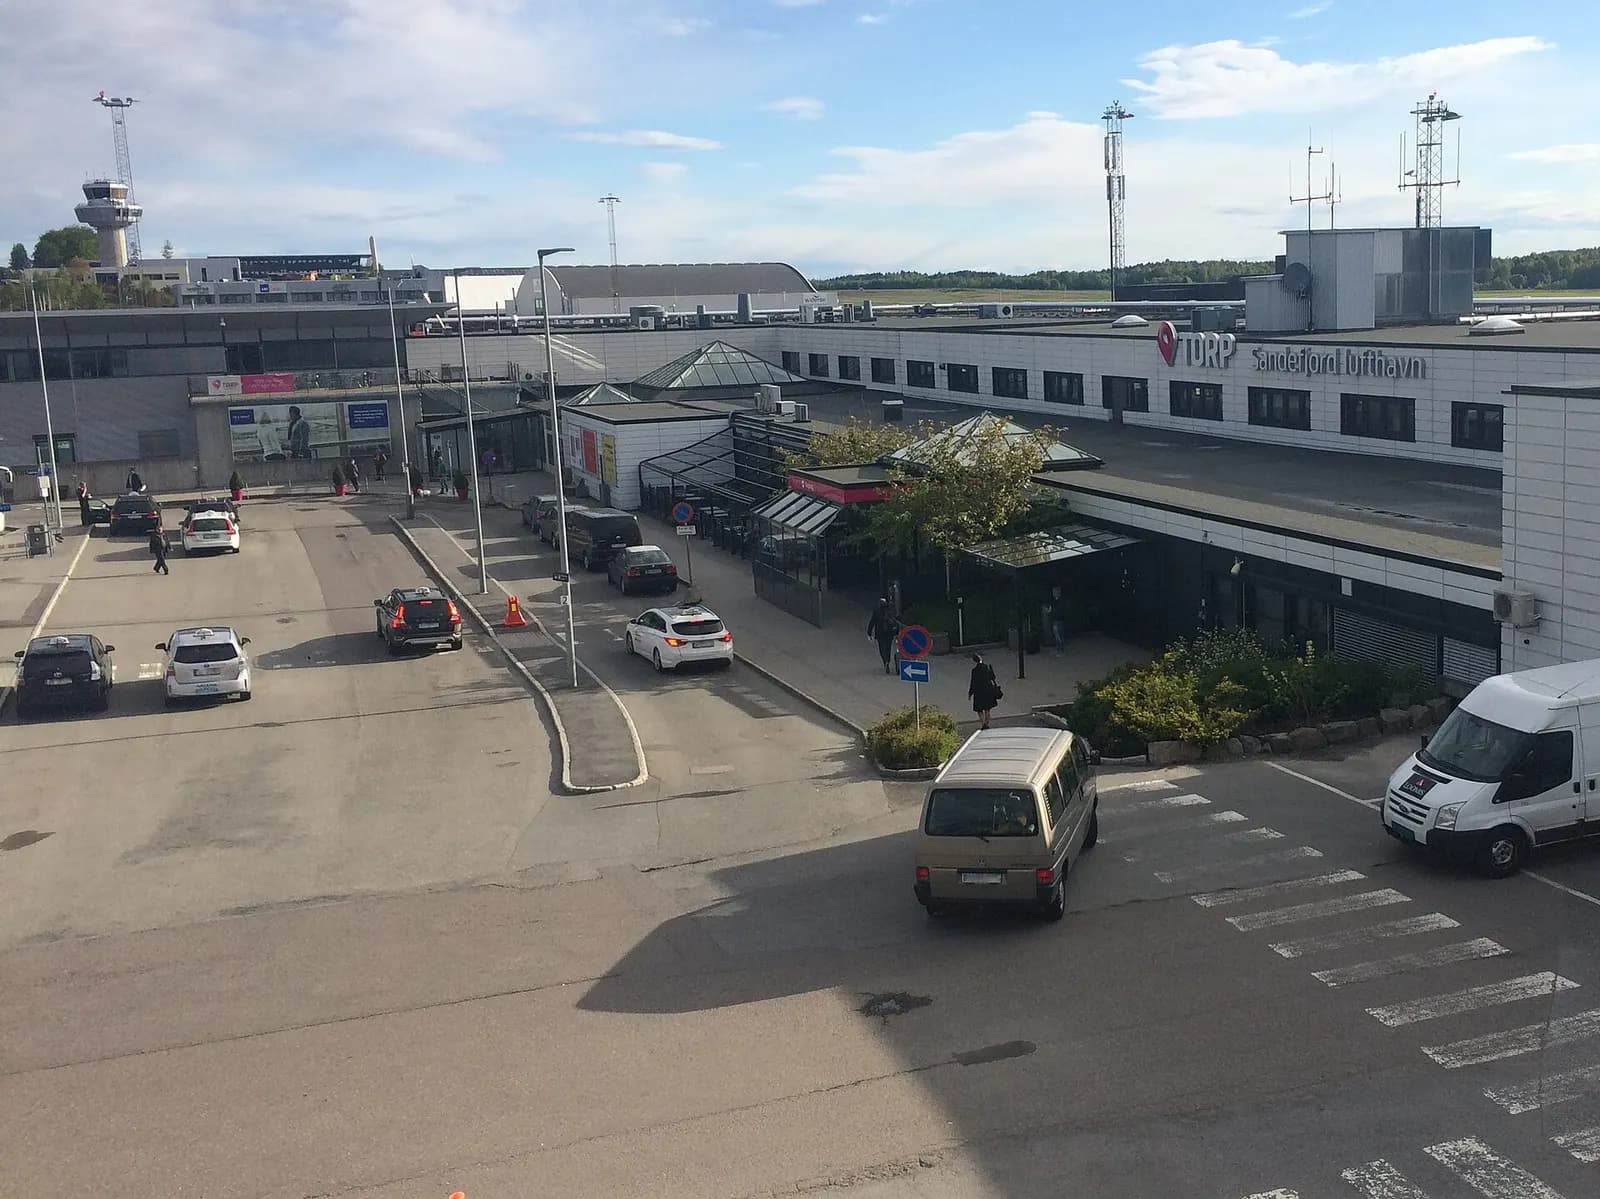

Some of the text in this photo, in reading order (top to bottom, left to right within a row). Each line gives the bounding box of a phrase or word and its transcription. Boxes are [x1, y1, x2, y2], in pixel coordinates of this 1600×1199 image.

[1178, 332, 1236, 368] TORP
[1252, 347, 1425, 379] Sandefjord lufthavn
[562, 596, 568, 605] 2
